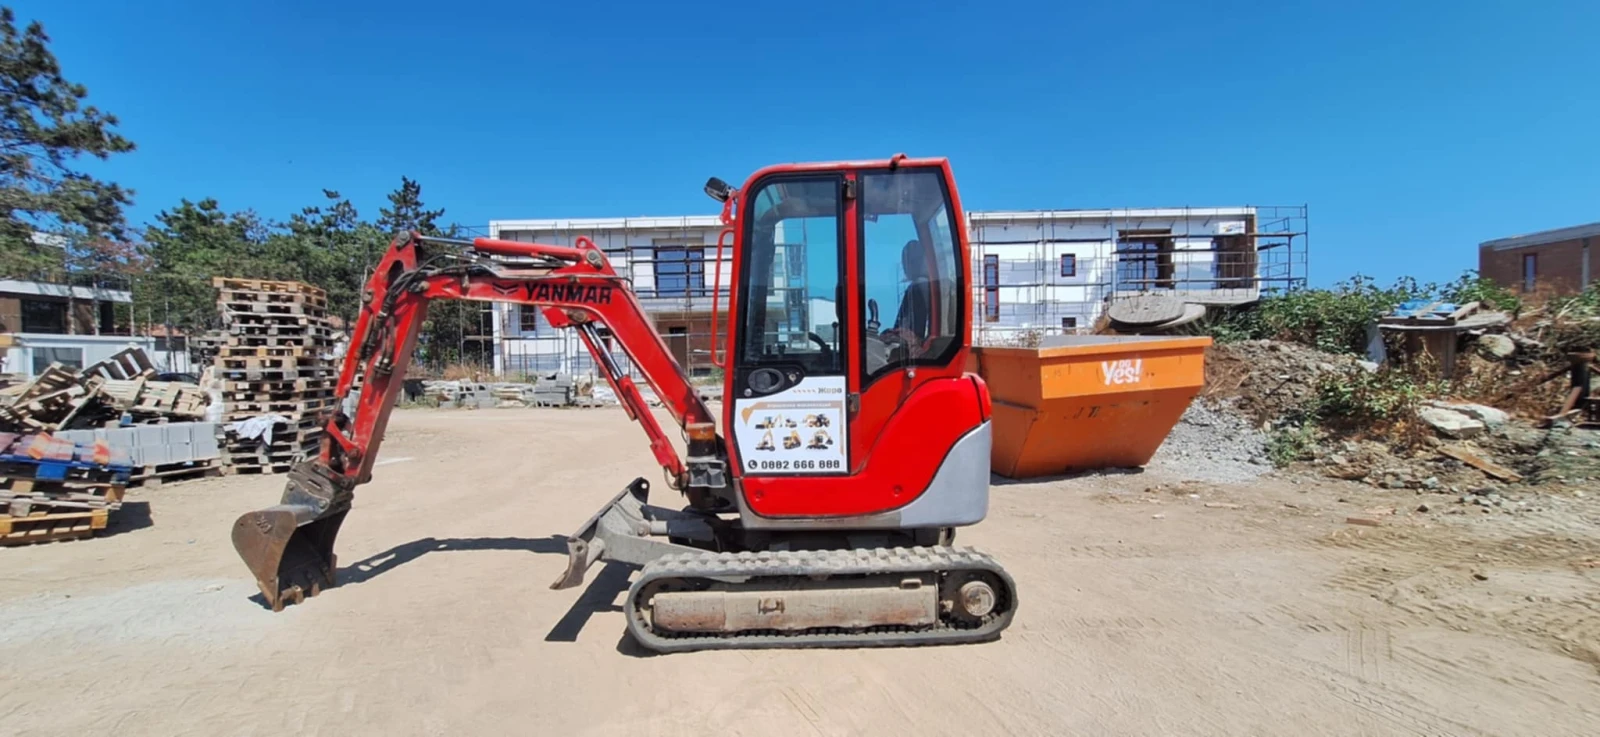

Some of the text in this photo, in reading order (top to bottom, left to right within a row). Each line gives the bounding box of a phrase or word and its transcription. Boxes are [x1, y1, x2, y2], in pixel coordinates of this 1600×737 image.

[525, 282, 612, 304] YANMAR
[1101, 359, 1142, 386] Yes!
[761, 460, 840, 469] 0882 666 888
